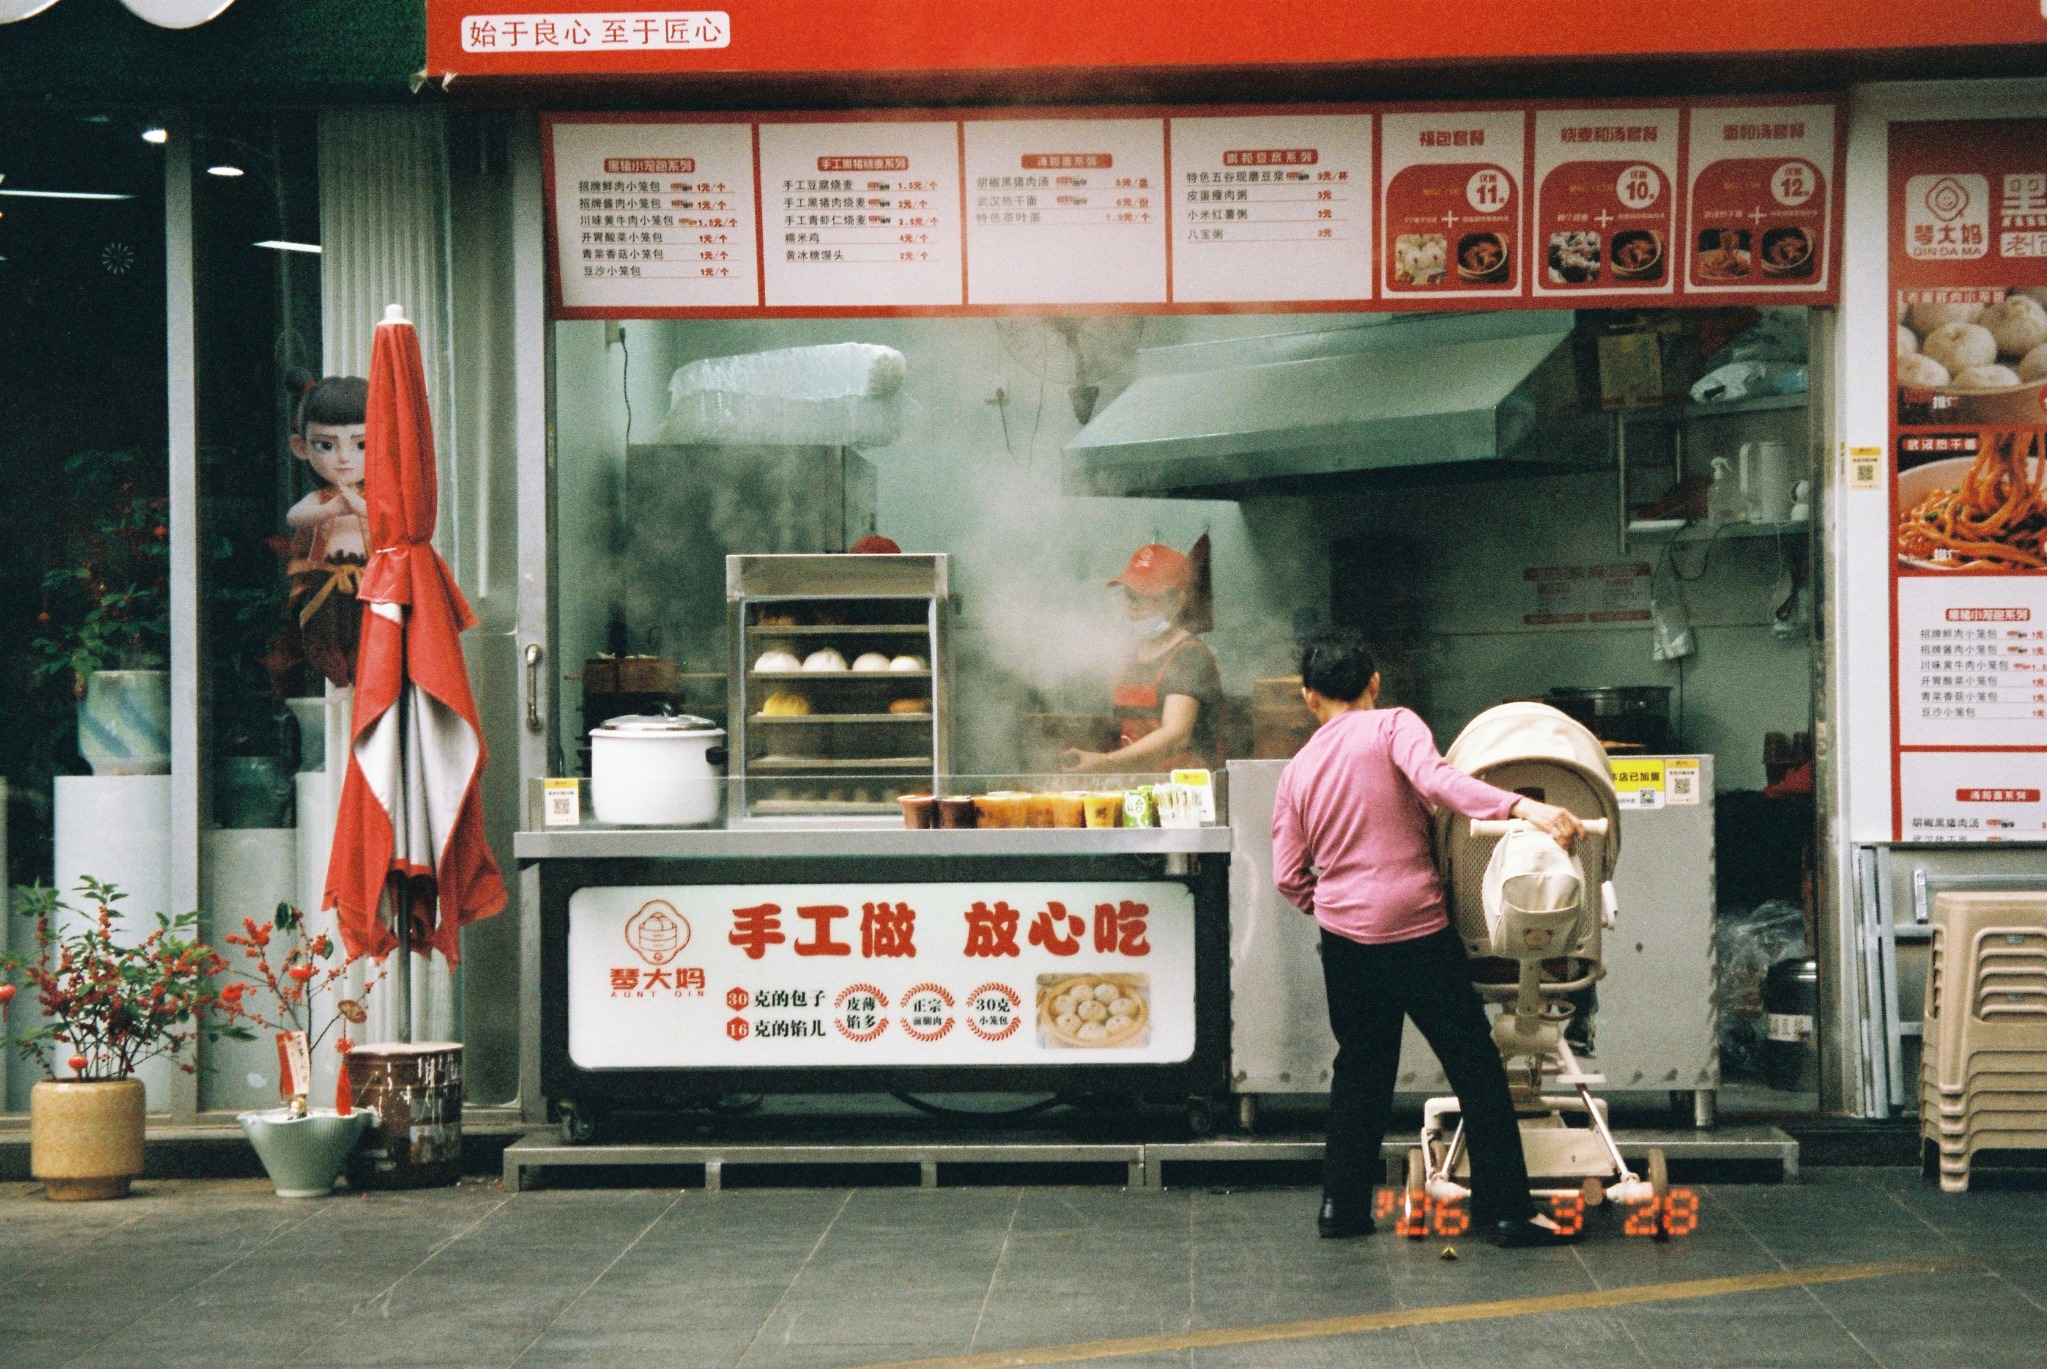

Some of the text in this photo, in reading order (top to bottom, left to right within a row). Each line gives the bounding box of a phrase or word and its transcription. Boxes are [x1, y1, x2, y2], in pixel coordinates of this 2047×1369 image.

[469, 16, 722, 48] 始于良心 至于匠心
[578, 180, 660, 192] 招牌鲜肉小笼包
[579, 198, 662, 210] 招牌酱肉小笼包
[784, 197, 865, 209] 手工黑猪肉烧麦
[580, 215, 674, 227] 川味黄牛肉小笼包
[581, 232, 663, 243] 开胃酸菜小笼包
[785, 233, 820, 244] 糯米鸡
[1188, 228, 1223, 240] 八宝粥
[582, 249, 664, 260] 青菜香菇小笼包
[583, 266, 641, 277] 豆沙小笼包
[728, 900, 1151, 960] 手工做 放心吃
[610, 967, 705, 990] 琴大妈
[611, 990, 657, 998] AUNT
[728, 989, 826, 1008] 30 克的包子
[847, 996, 876, 1012] 皮薄
[913, 998, 942, 1013] 正宗
[976, 997, 1011, 1013] 30克
[847, 1014, 876, 1030] 馅多
[979, 1015, 1009, 1026] 小笼包
[730, 1019, 826, 1038] 16 克的馅儿
